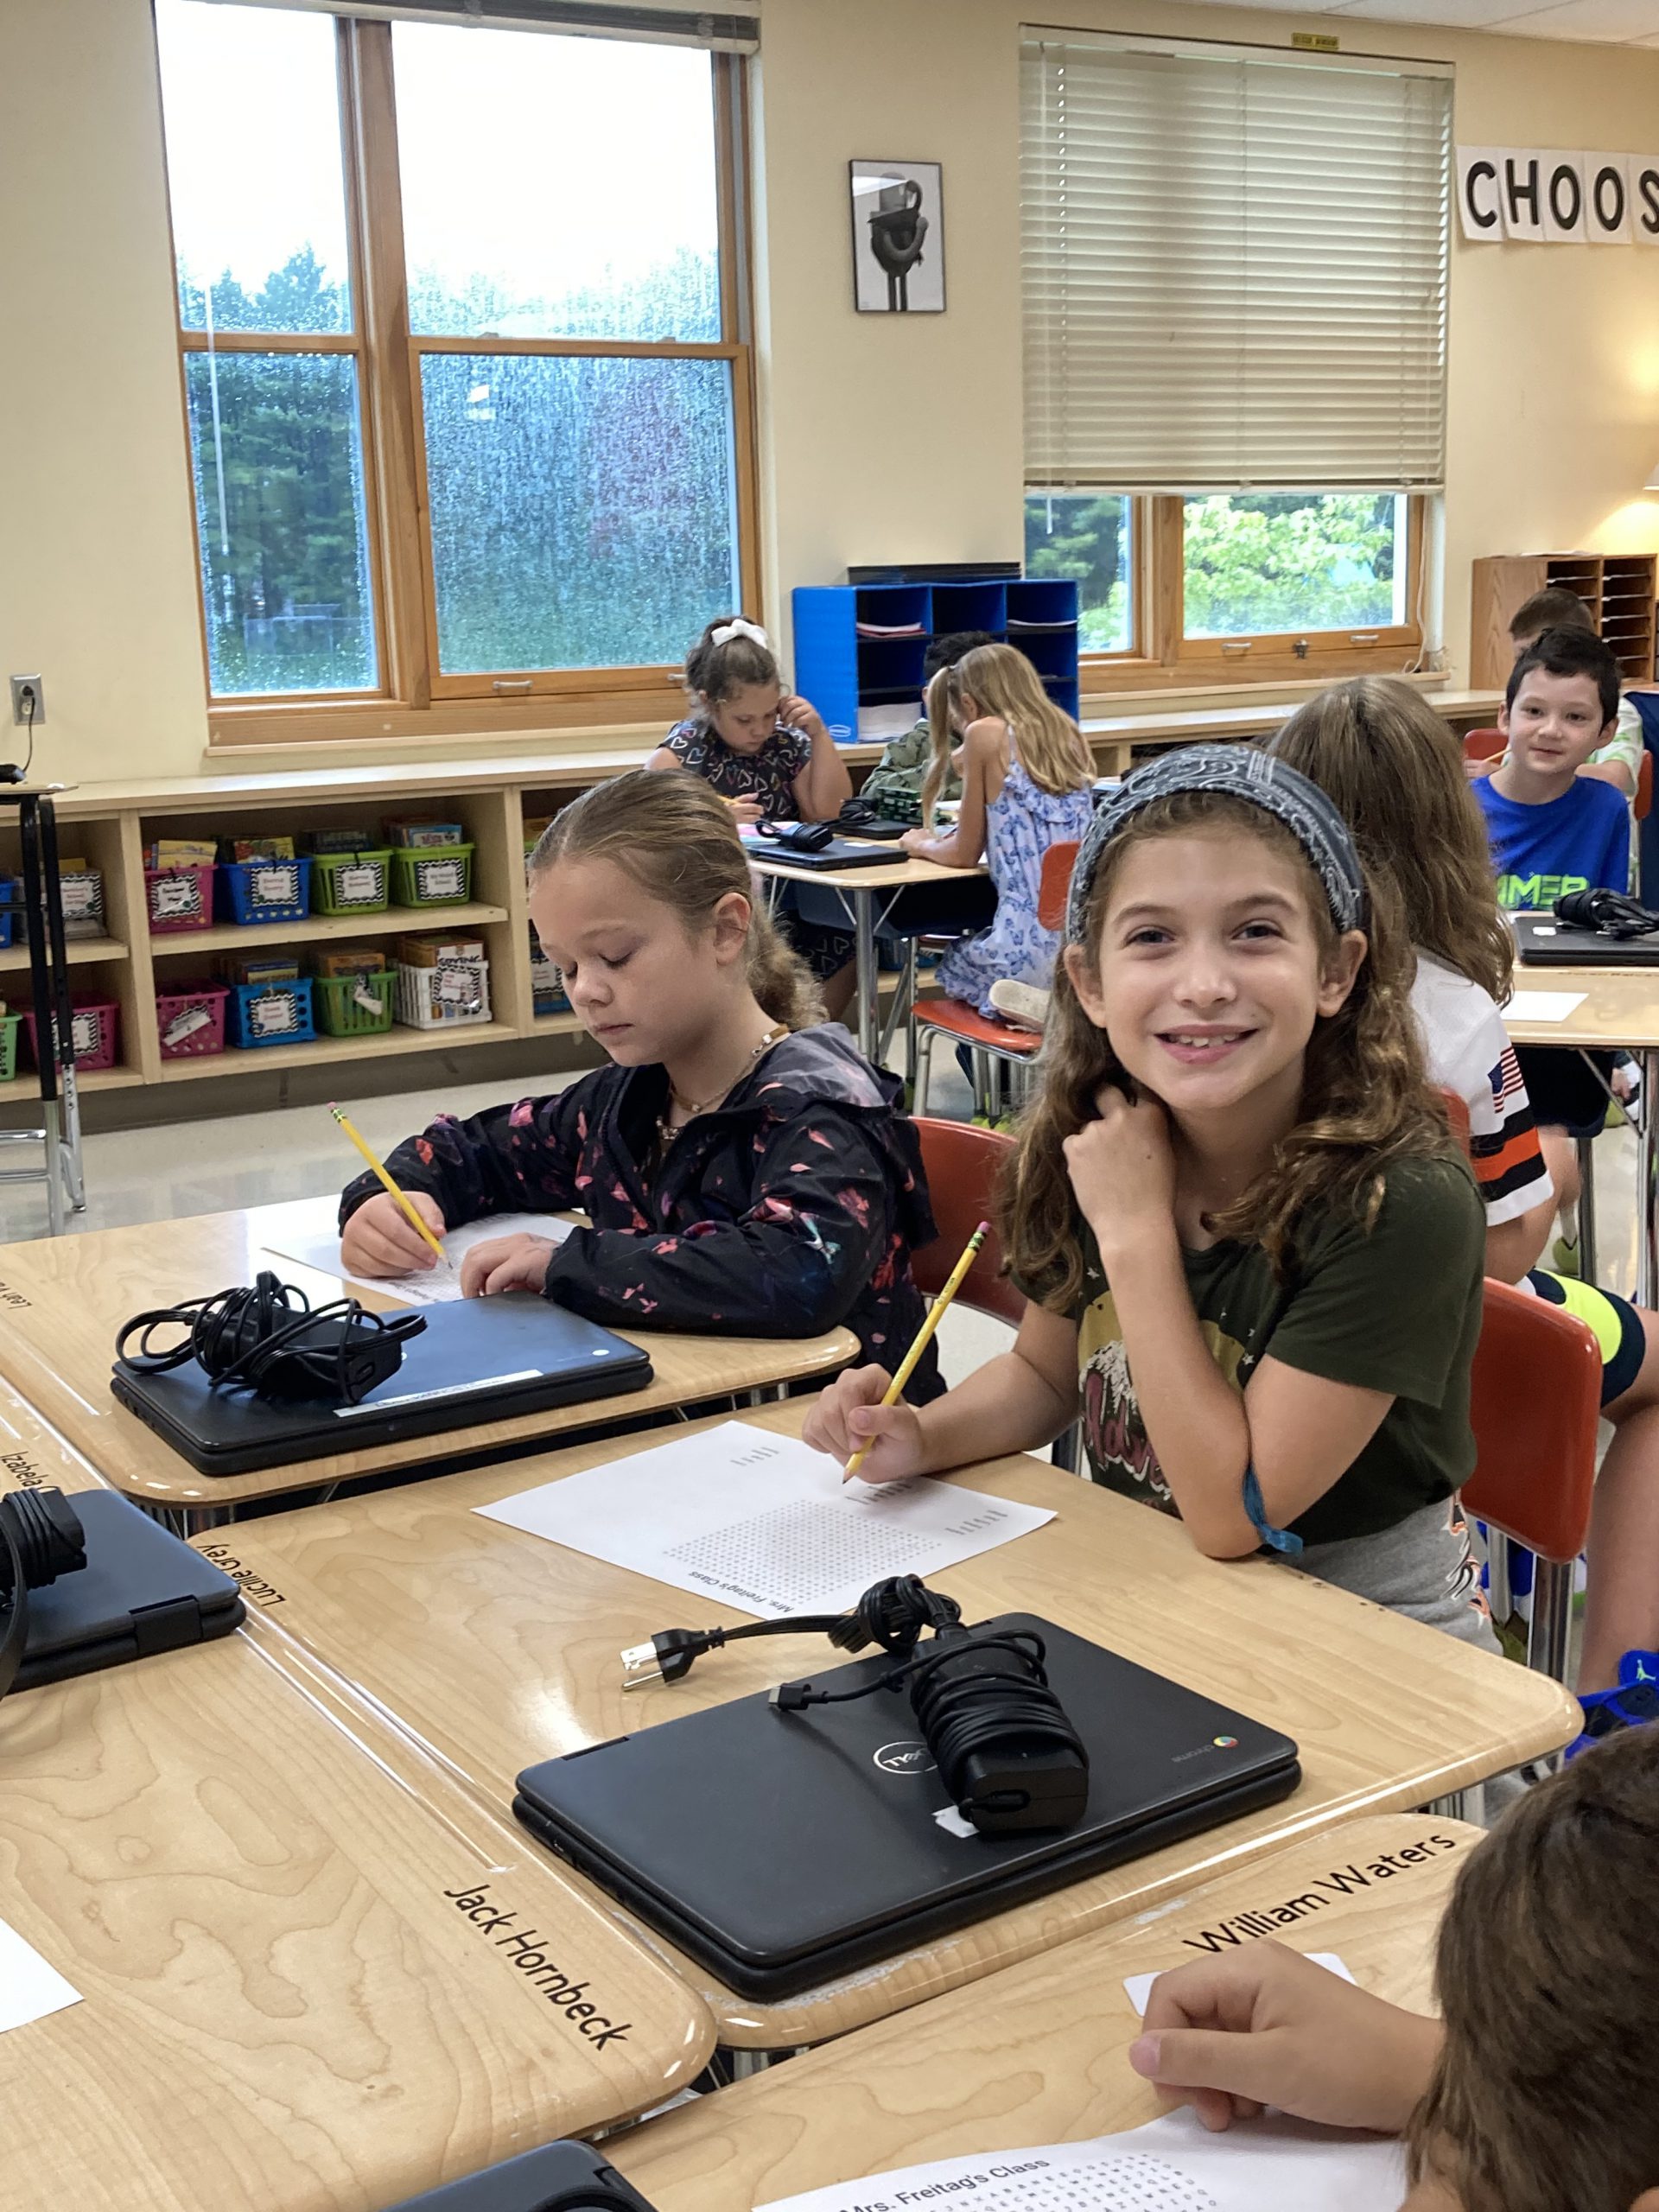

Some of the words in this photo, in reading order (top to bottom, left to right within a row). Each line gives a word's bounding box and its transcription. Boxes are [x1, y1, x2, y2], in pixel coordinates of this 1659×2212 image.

[1466, 159, 1659, 234] CHOOS
[0, 1452, 49, 1487] Izabela
[231, 1570, 286, 1607] Lucille
[689, 1572, 720, 1586] Class
[719, 1583, 767, 1603] Freitag's
[1181, 1892, 1331, 1954] William
[1313, 1833, 1457, 1895] Waters
[443, 1884, 518, 1936] Jack
[494, 1929, 632, 2051] Hornbeck
[894, 2172, 989, 2204] Freitag's
[988, 2158, 1050, 2178] Class
